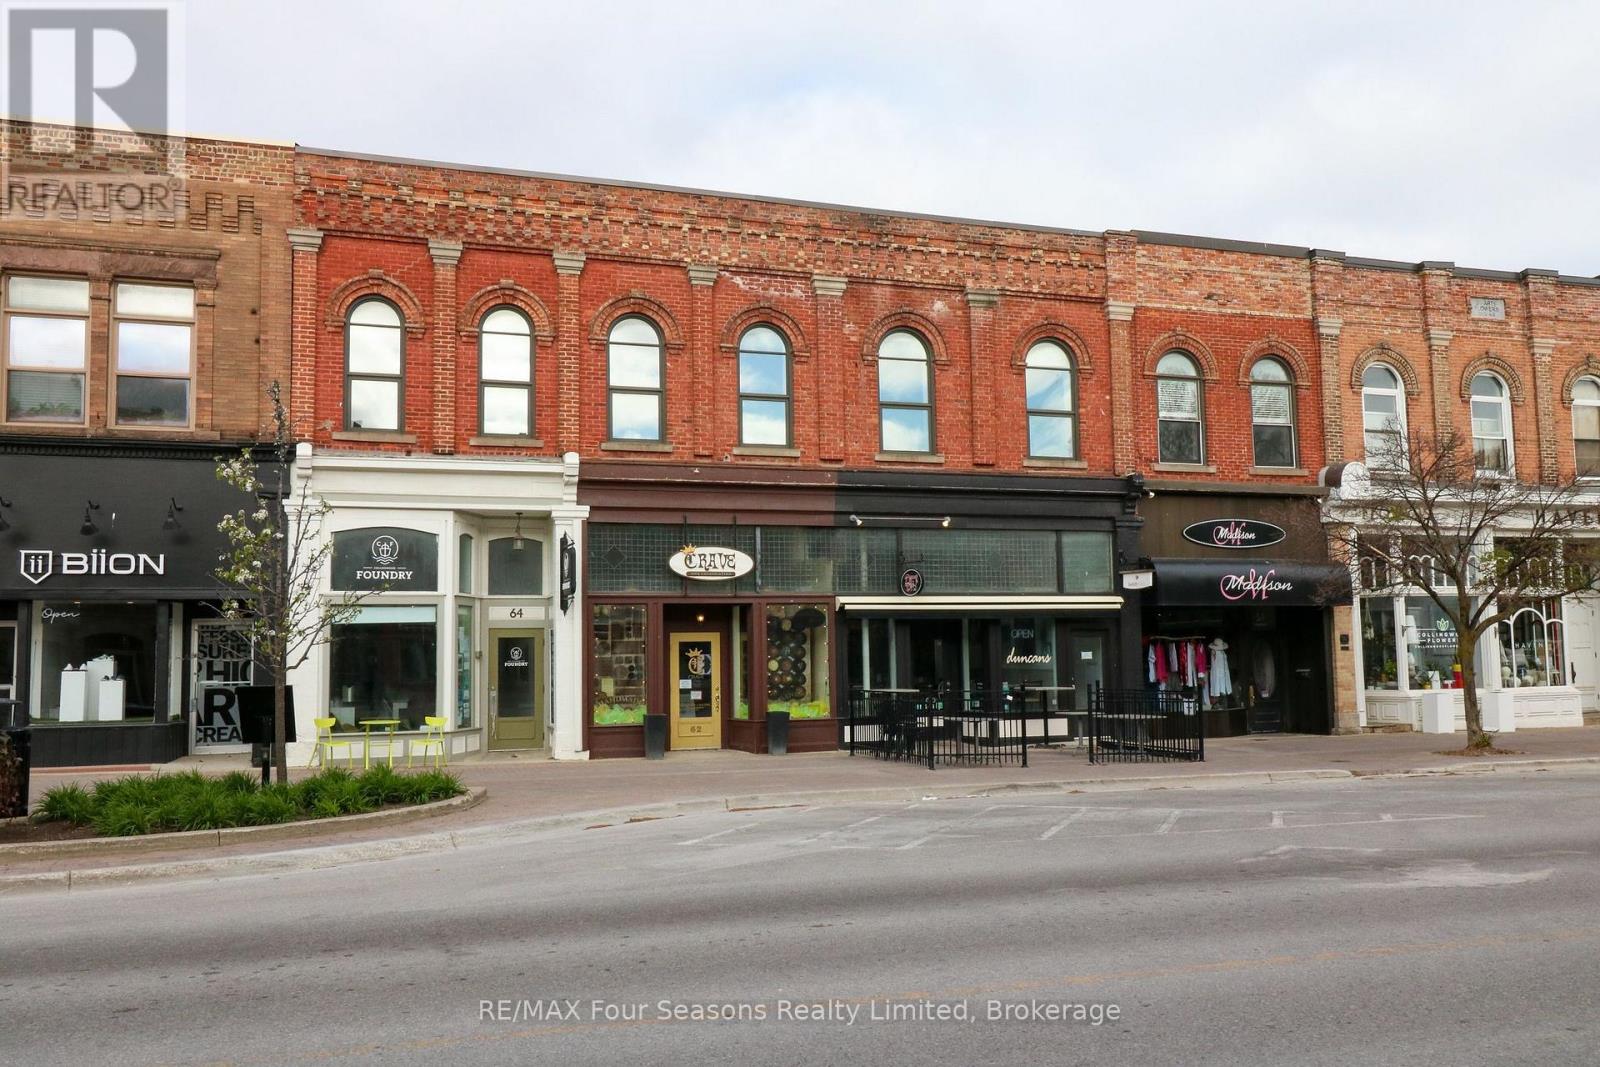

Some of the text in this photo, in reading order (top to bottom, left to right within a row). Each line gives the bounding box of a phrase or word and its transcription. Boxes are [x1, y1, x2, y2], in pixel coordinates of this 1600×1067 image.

[1217, 527, 1256, 540] Madison
[684, 552, 736, 571] CRAVE
[355, 571, 413, 580] FOUNDRY
[1225, 574, 1293, 592] Madison
[41, 608, 80, 624] Open
[509, 608, 523, 619] 64
[1011, 628, 1034, 639] OPEN
[1006, 646, 1052, 664] duncans
